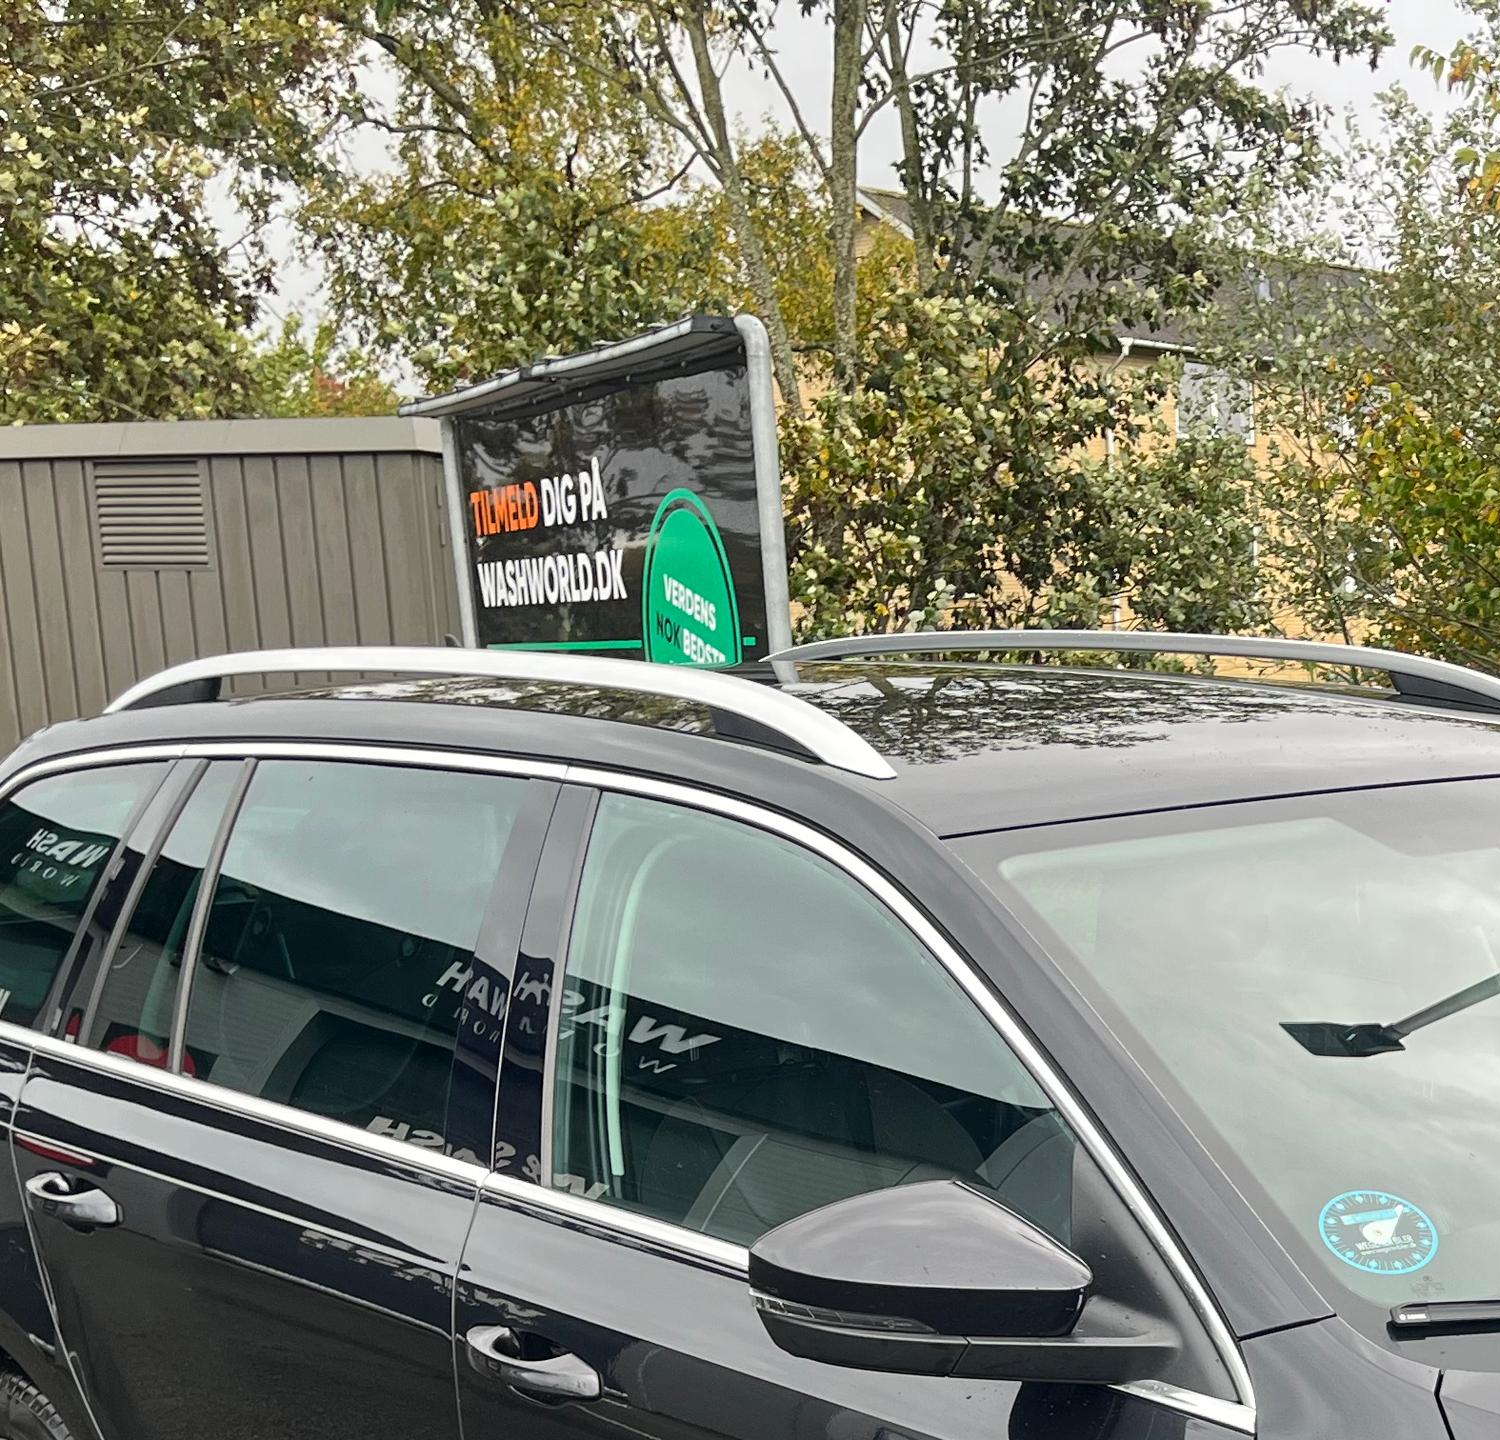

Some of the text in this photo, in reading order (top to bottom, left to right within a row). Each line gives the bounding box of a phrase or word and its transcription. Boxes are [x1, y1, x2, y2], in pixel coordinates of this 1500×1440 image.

[470, 456, 608, 537] TILMELD DIG PÅ
[476, 549, 628, 608] WASHWORLD.DK
[663, 573, 717, 632] VERDENS
[656, 611, 681, 650] NOK
